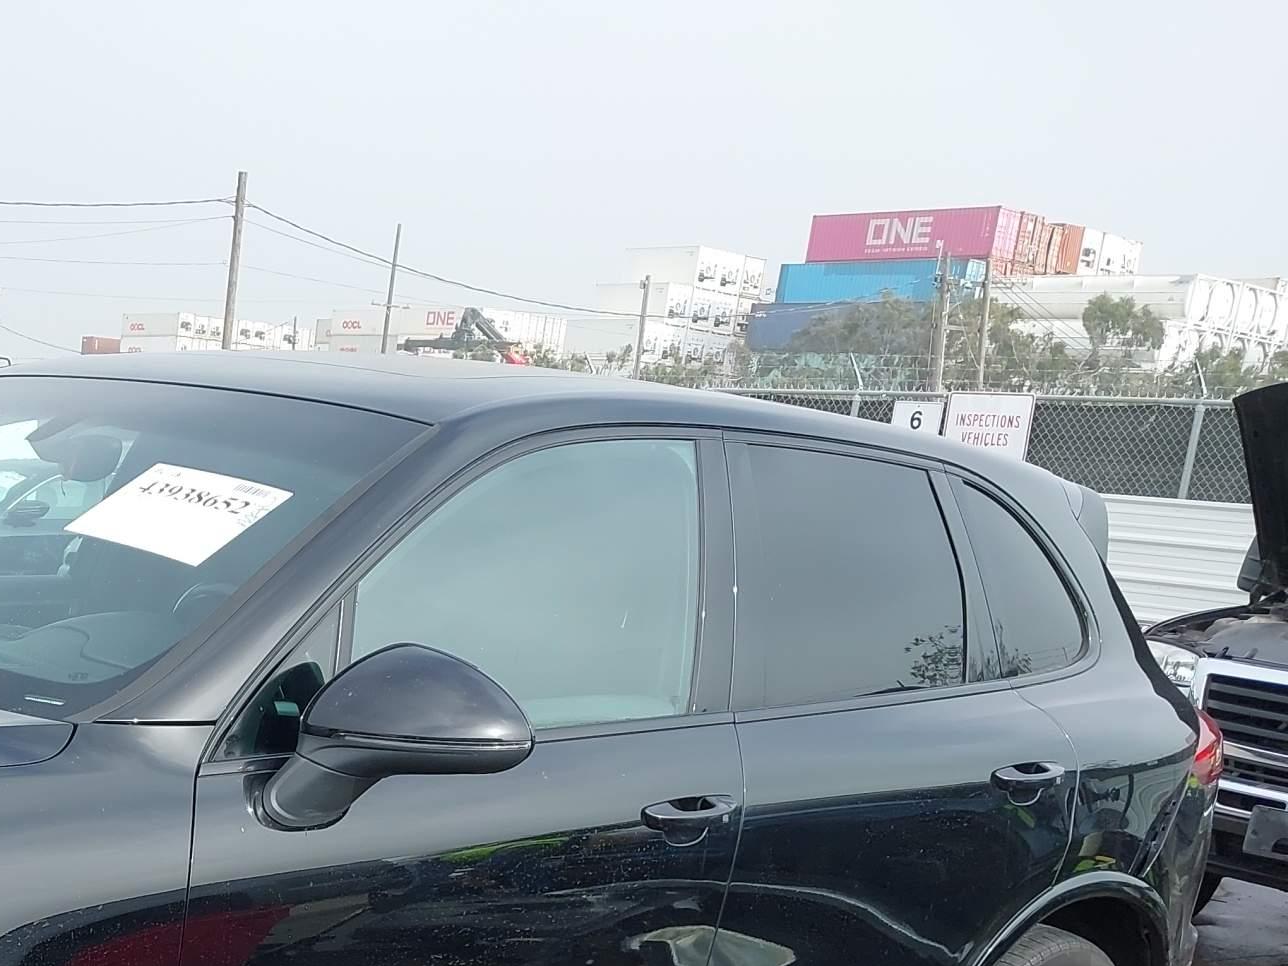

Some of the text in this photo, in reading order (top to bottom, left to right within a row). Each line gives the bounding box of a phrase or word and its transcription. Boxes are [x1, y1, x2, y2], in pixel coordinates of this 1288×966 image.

[866, 216, 934, 246] ONE
[342, 320, 362, 330] OOCL
[426, 311, 456, 326] ONE
[909, 410, 923, 430] 6
[955, 413, 1021, 429] INSPECTIONS
[961, 431, 1009, 447] VEHICLES
[139, 481, 251, 514] 43938652
